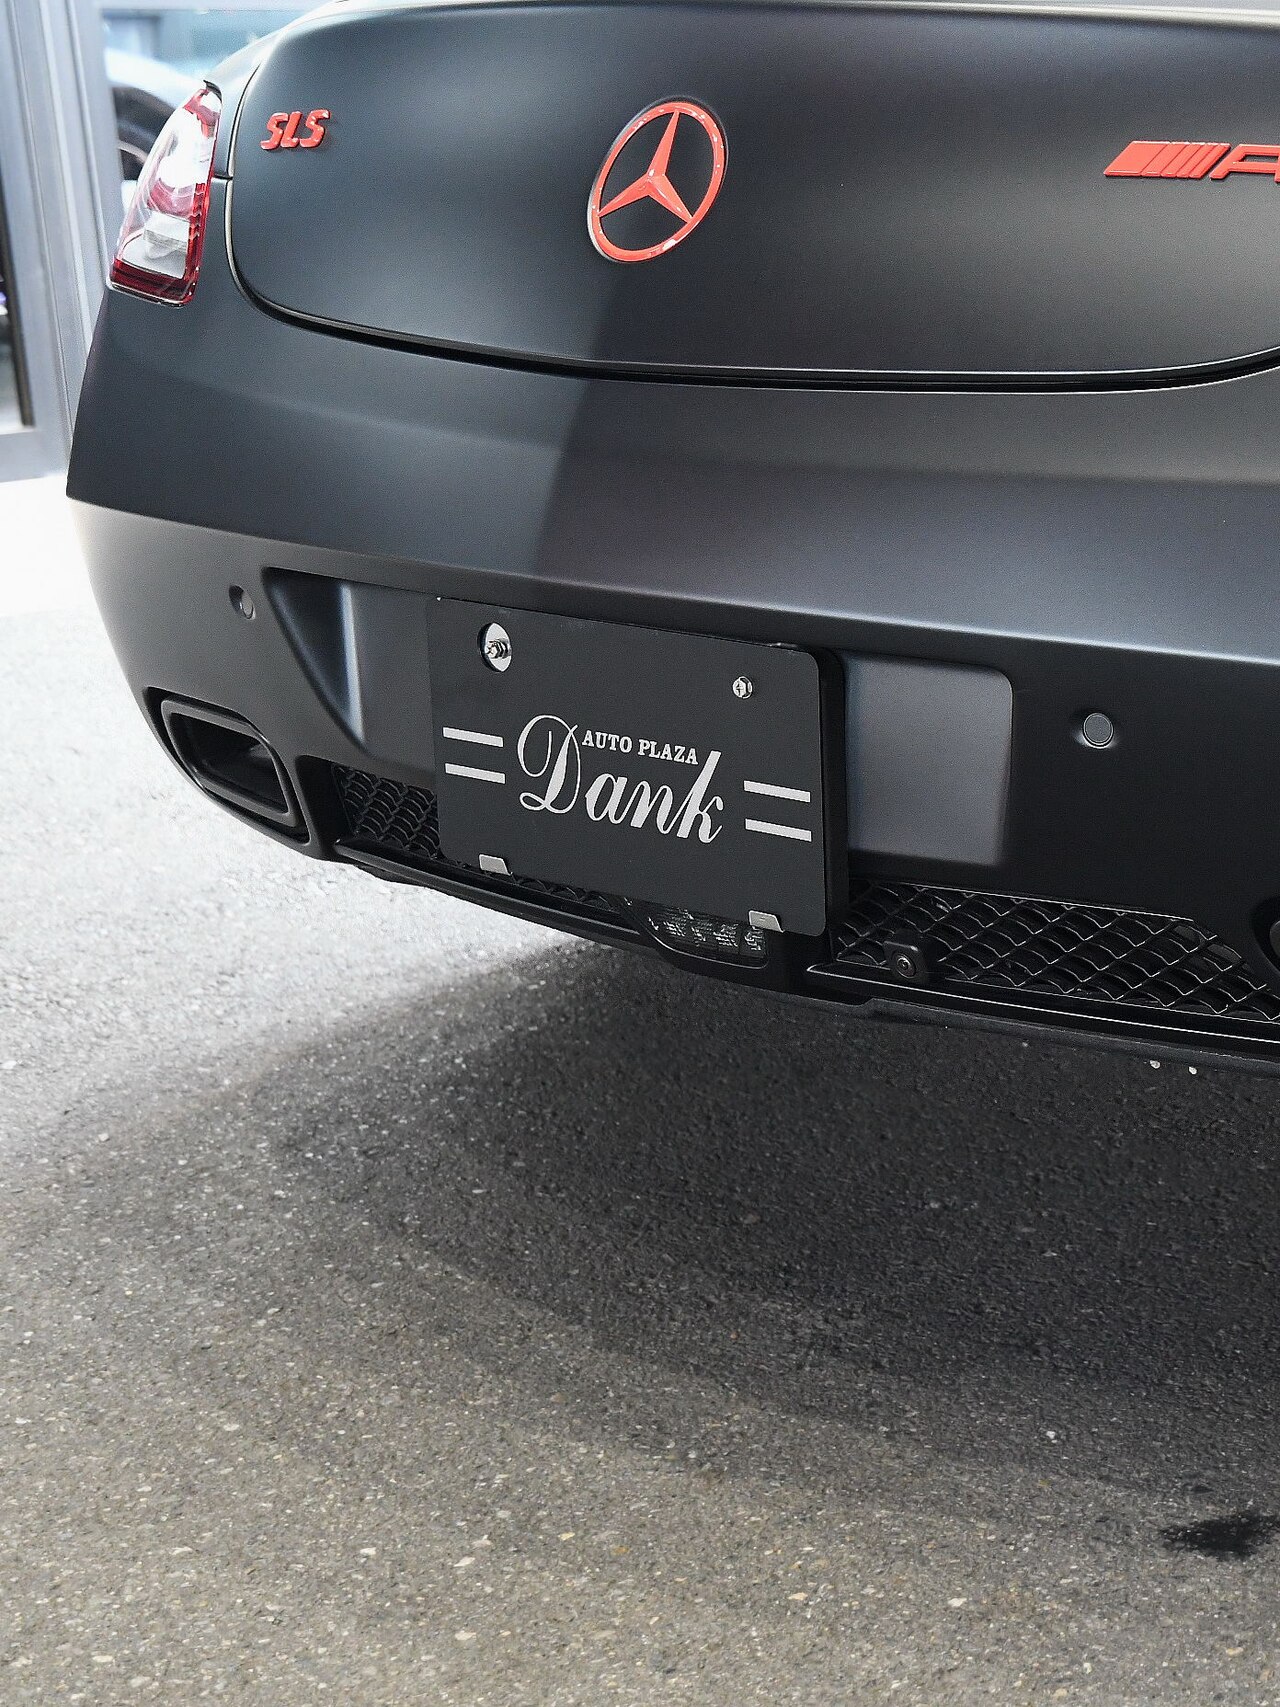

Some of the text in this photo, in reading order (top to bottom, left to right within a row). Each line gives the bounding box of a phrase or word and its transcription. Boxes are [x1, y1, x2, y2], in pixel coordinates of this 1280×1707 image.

[260, 109, 331, 150] SLS
[582, 729, 699, 766] AUTO PLAZA
[516, 714, 725, 844] Dank
